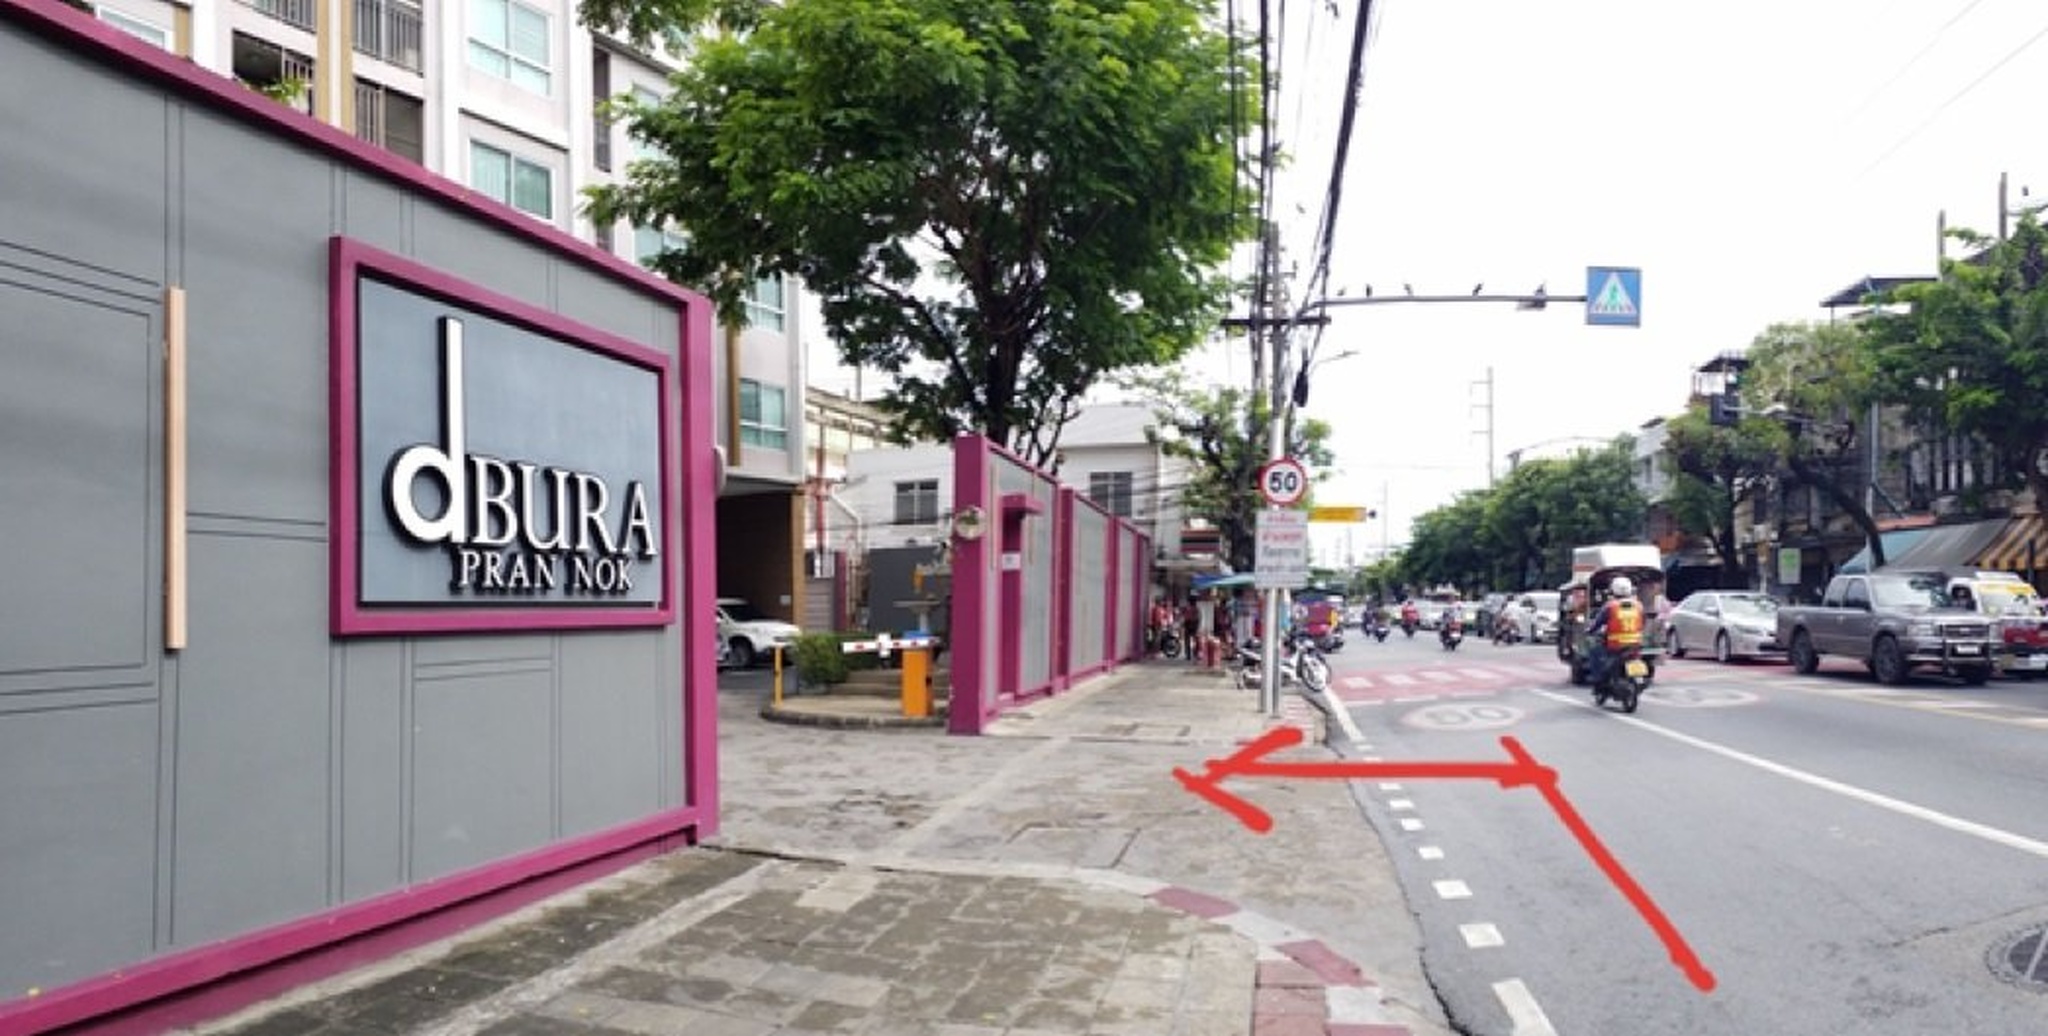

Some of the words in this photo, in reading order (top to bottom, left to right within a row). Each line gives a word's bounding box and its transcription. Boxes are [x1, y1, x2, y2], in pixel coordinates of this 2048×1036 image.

[1269, 471, 1297, 493] 50
[456, 549, 557, 592] PRAN
[570, 558, 634, 594] NOK
